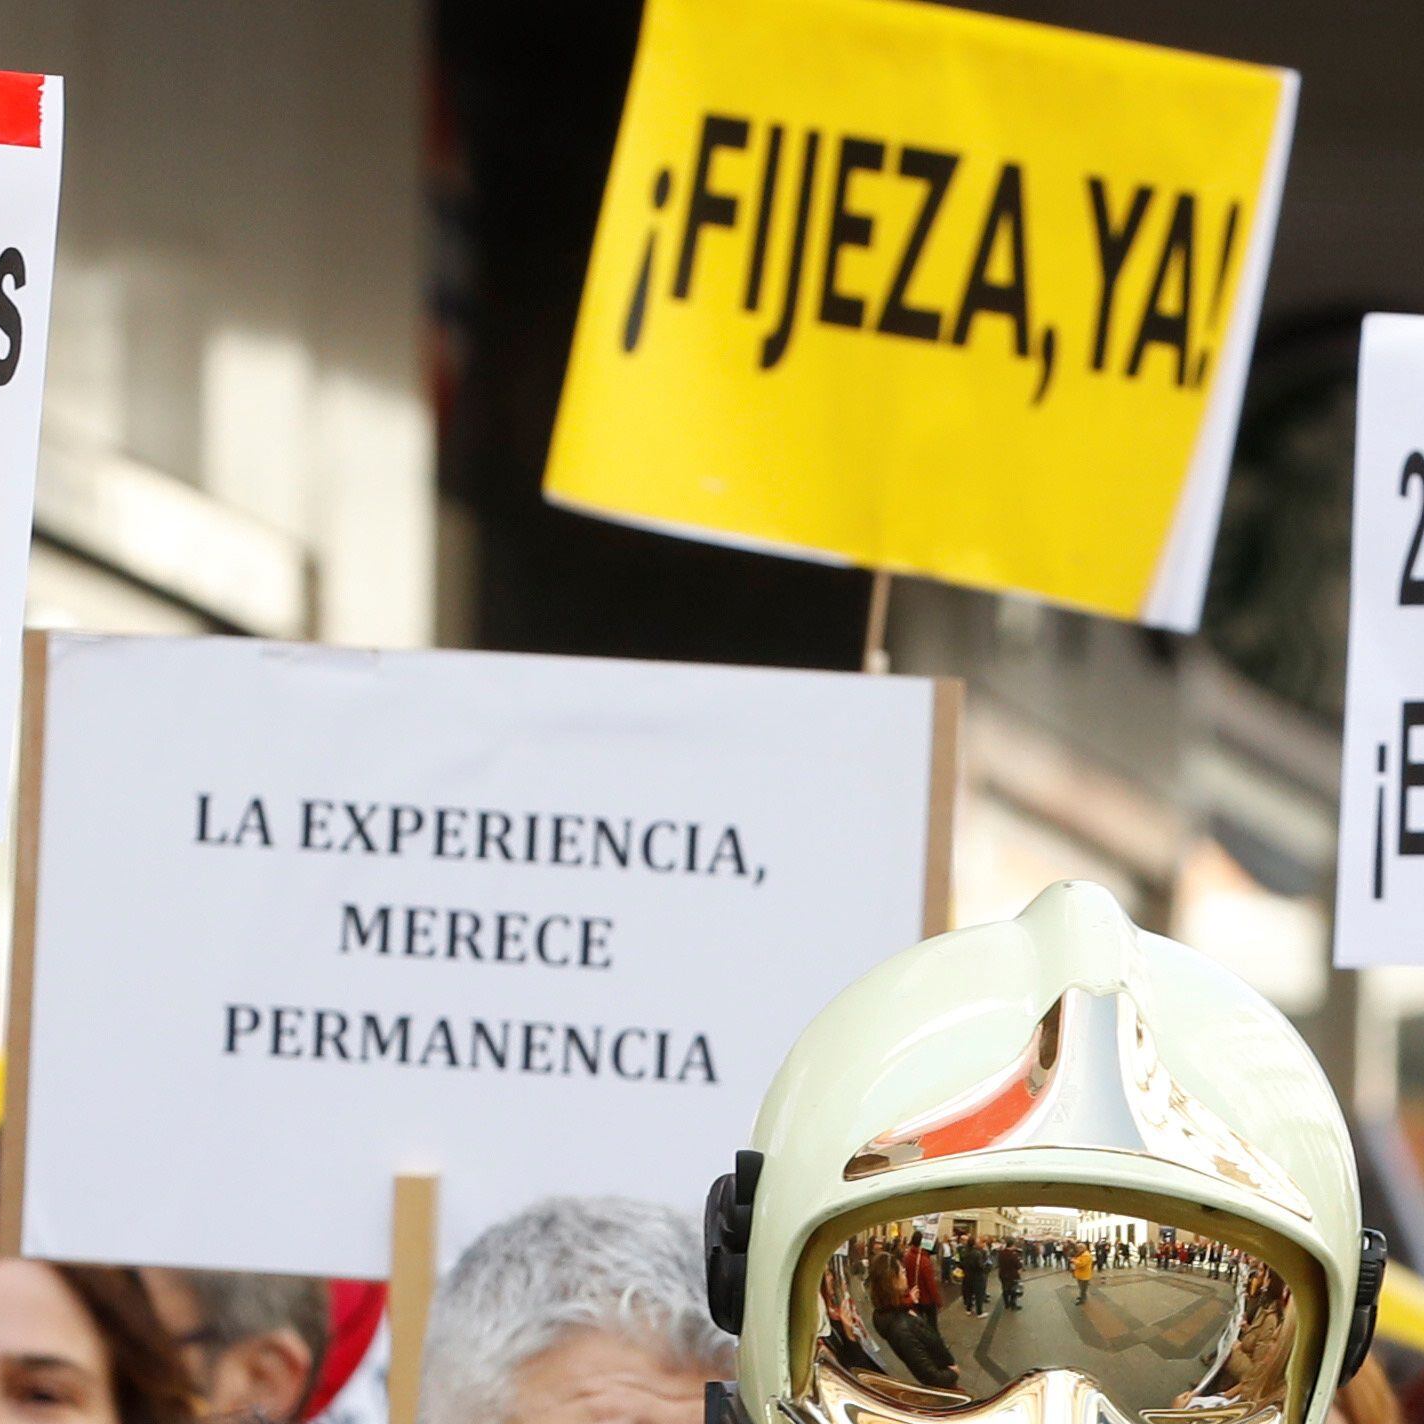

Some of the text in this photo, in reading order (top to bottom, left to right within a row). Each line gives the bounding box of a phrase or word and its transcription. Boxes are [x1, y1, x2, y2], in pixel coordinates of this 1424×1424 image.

[622, 112, 1242, 405] ¡FIJEZA, YA!
[192, 793, 769, 886] LA EXPERIENCIA,
[337, 902, 616, 970] MERECE
[220, 1003, 721, 1084] PERMANENCIA
